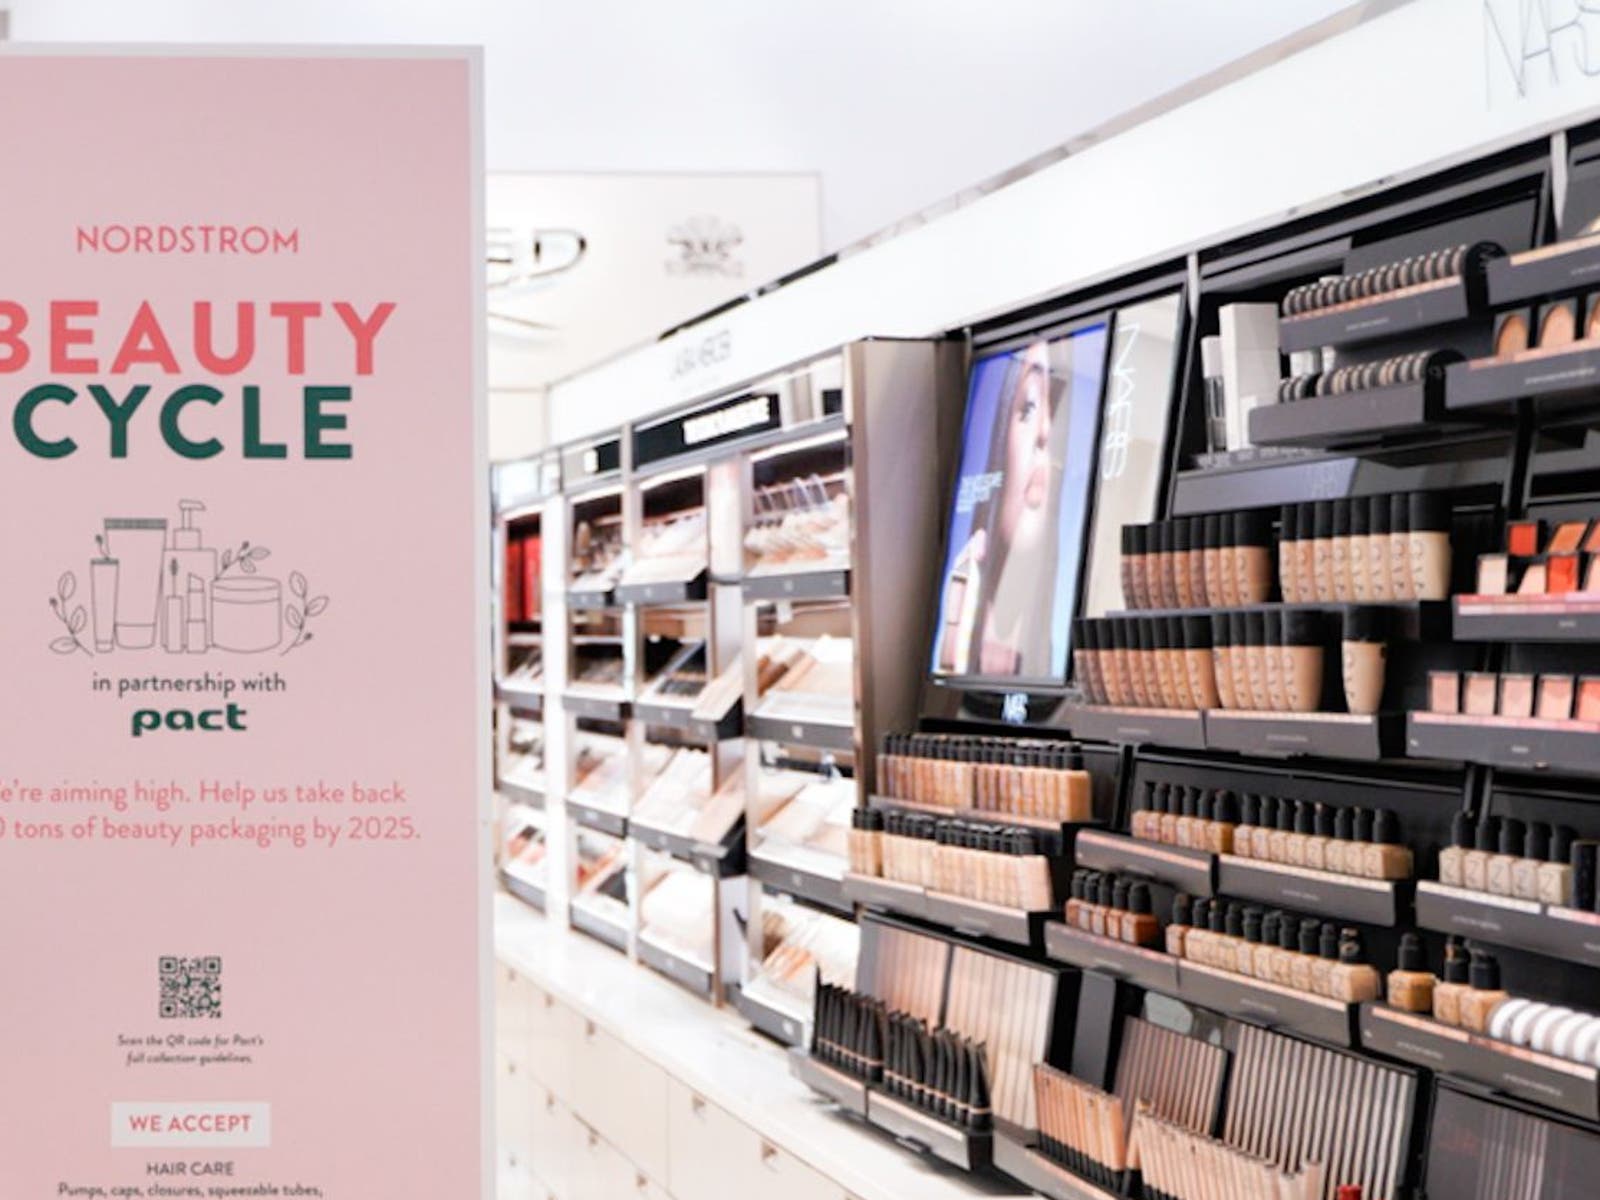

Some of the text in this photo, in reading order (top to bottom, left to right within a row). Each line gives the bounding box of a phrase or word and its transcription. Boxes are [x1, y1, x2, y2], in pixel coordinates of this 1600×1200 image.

[77, 225, 298, 254] NORDSTROM
[13, 383, 352, 460] CYCLE
[93, 672, 286, 698] in partnership with
[132, 703, 247, 737] pact
[50, 780, 128, 812] aiming
[134, 780, 191, 812] high.
[200, 780, 256, 811] Help
[263, 788, 288, 803] us
[296, 780, 344, 803] take
[352, 781, 405, 803] back
[14, 821, 64, 839] tons
[71, 815, 97, 839] of
[103, 816, 183, 847] beauty
[190, 816, 306, 848] packaging
[313, 816, 341, 848] by
[349, 816, 420, 839] 2025.
[129, 1115, 251, 1132] WE ACCEPT
[147, 1162, 233, 1176] HAIR CARE
[208, 1184, 279, 1199] squeezable
